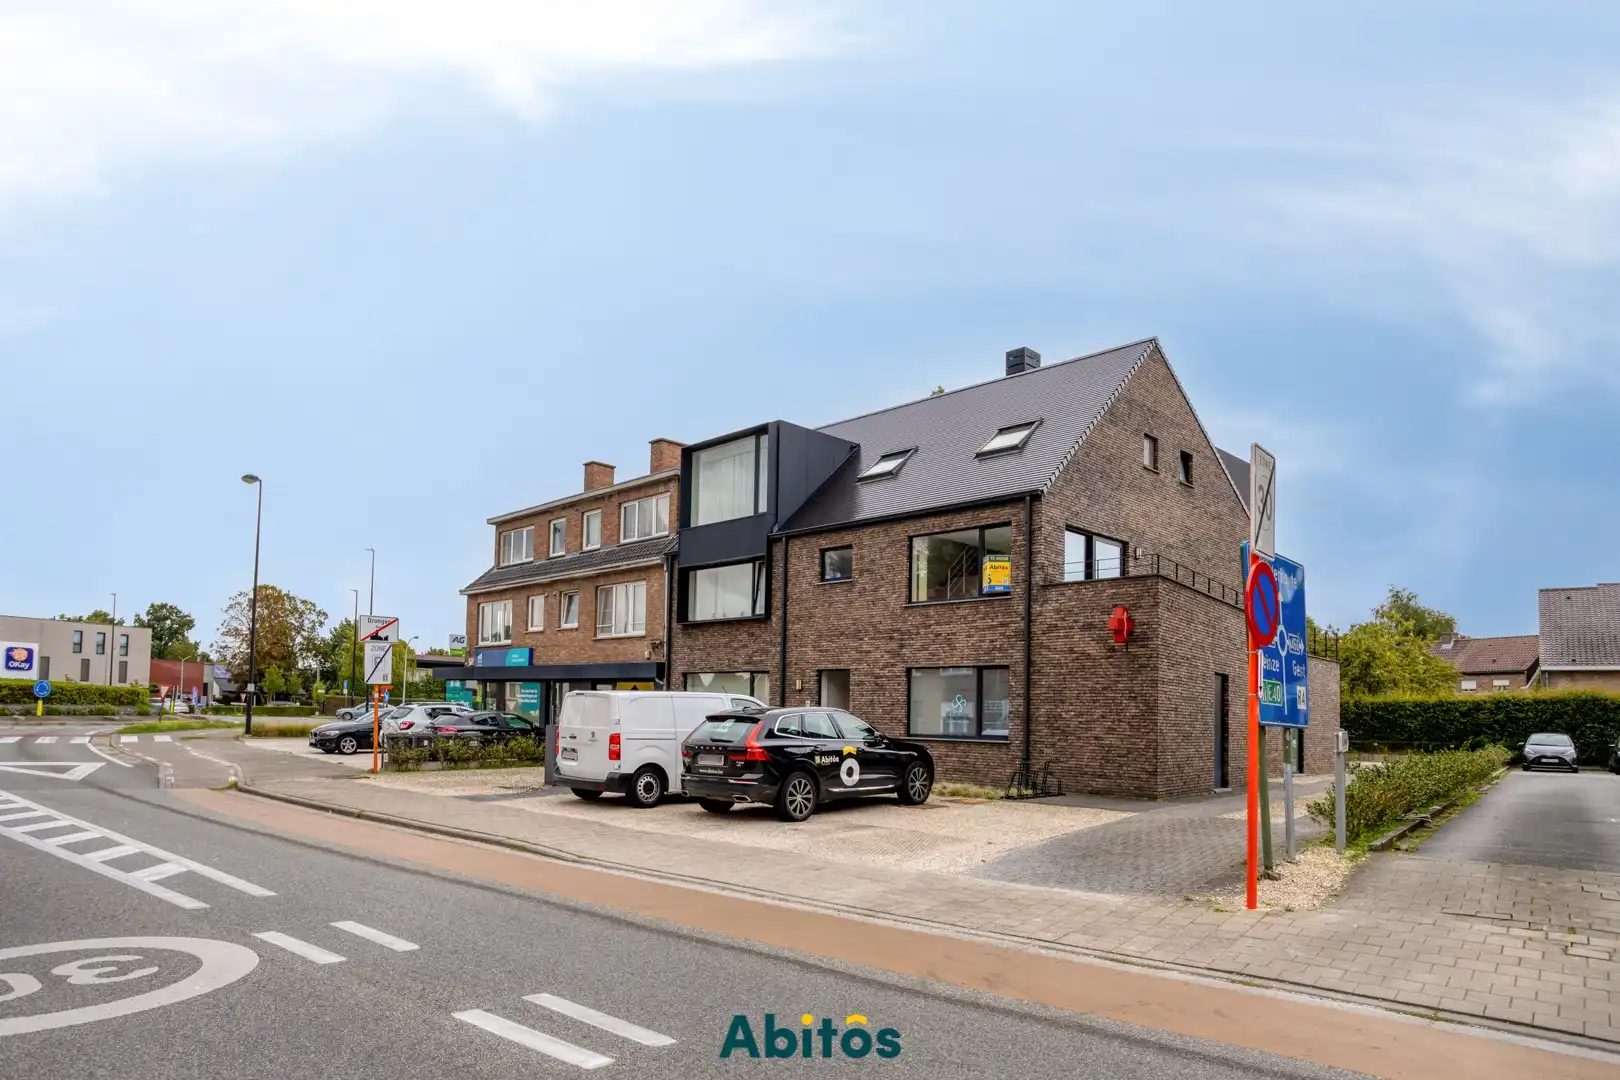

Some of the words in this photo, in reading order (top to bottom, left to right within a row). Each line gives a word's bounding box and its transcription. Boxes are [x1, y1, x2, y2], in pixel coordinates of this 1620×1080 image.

[1259, 454, 1271, 471] ZONE
[1258, 484, 1273, 521] 30
[368, 617, 392, 626] Drongen
[370, 644, 386, 652] ZONE
[452, 636, 466, 644] AG
[1263, 655, 1280, 672] einze
[1292, 660, 1306, 678] Gent
[1297, 688, 1305, 705] R4
